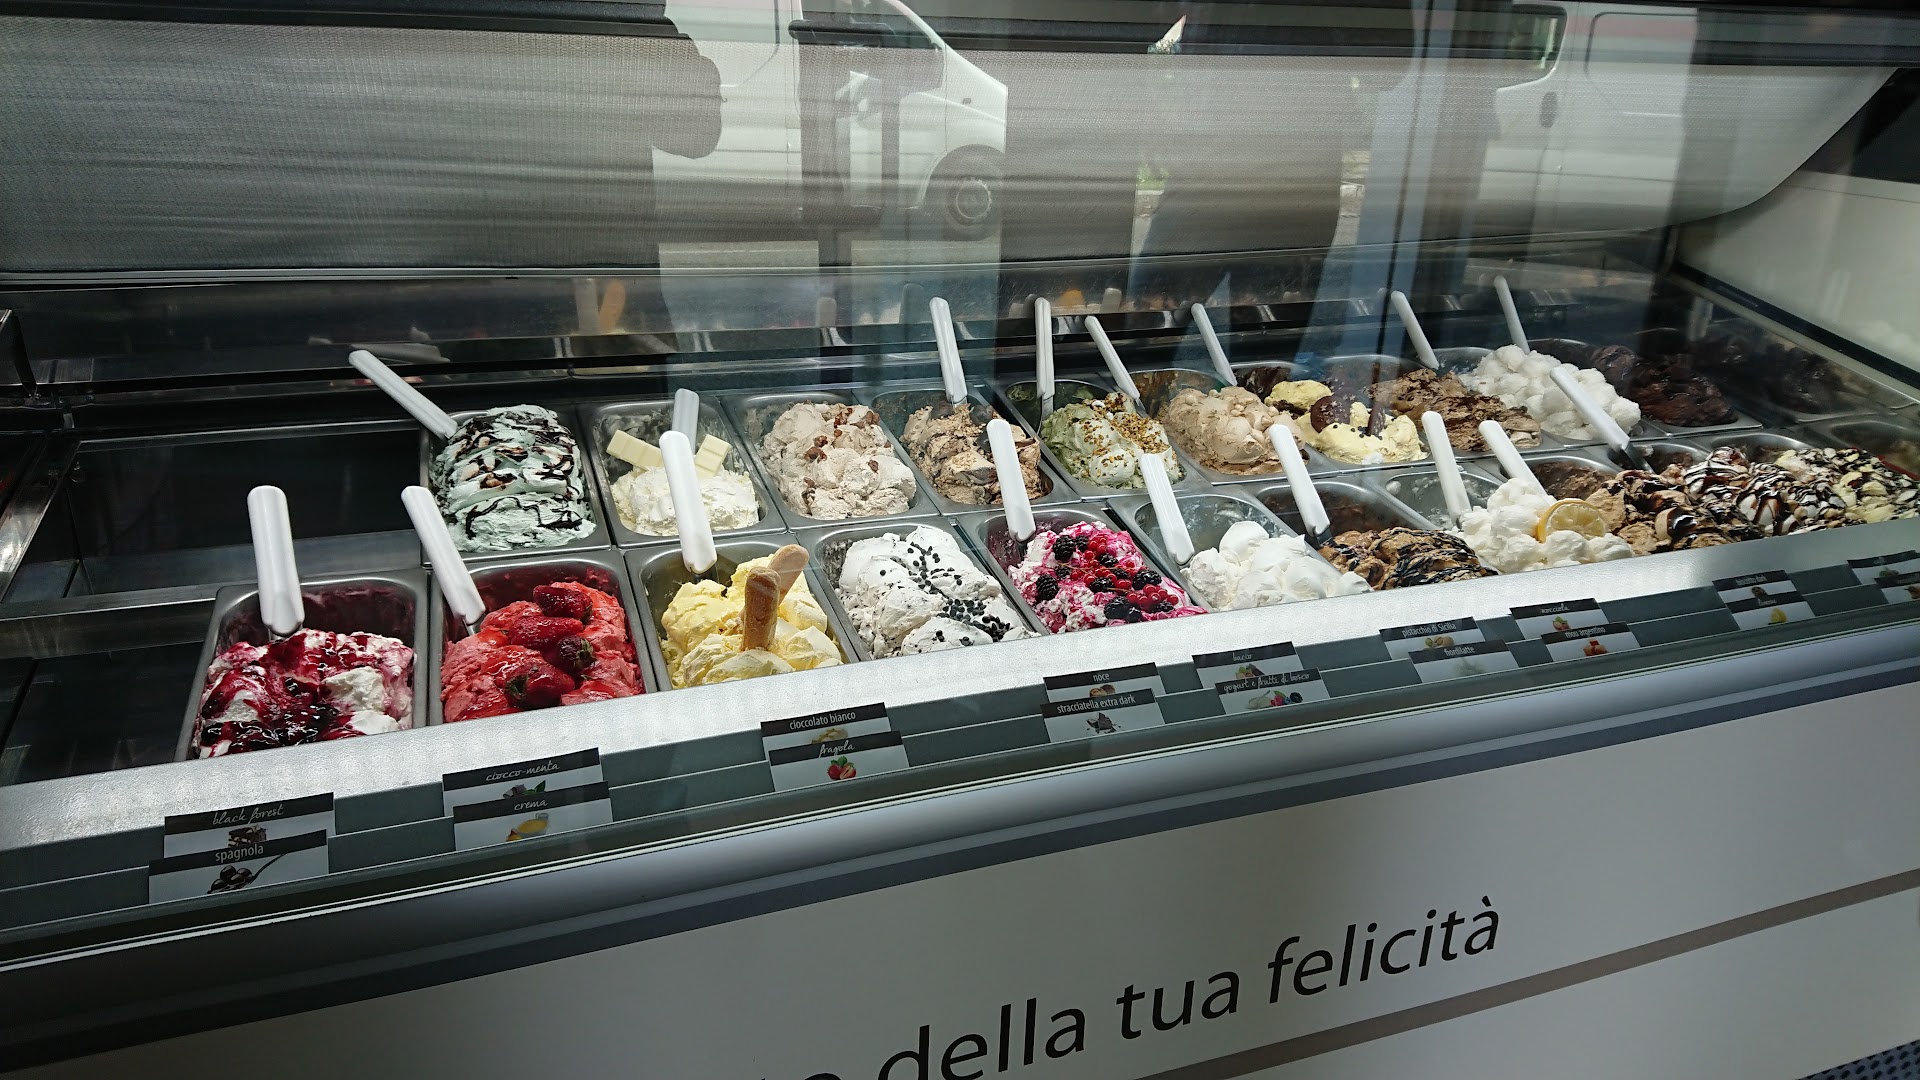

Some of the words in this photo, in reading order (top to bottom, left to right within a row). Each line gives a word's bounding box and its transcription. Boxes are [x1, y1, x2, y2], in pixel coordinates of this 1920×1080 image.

[1401, 626, 1432, 639] pistacchio
[1432, 624, 1439, 633] di
[1439, 622, 1457, 632] Sicilia
[1092, 672, 1110, 682] noce
[1223, 678, 1249, 694] yogurt
[1257, 675, 1280, 690] frutti
[1281, 672, 1289, 685] di
[1290, 671, 1311, 682] bosco
[1056, 699, 1100, 714] stracciatella
[1099, 697, 1119, 708] extra
[1119, 694, 1136, 705] dark
[789, 716, 829, 731] cioccolato
[830, 711, 856, 723] bianco
[818, 740, 856, 759] fragola
[485, 760, 560, 782] ciocco-menta
[212, 811, 247, 826] black
[247, 803, 285, 825] forest
[514, 799, 549, 812] crema
[214, 843, 265, 863] spagnola
[876, 997, 1086, 1080] della
[1115, 970, 1241, 1040] tua
[1267, 895, 1500, 1005] felicità
